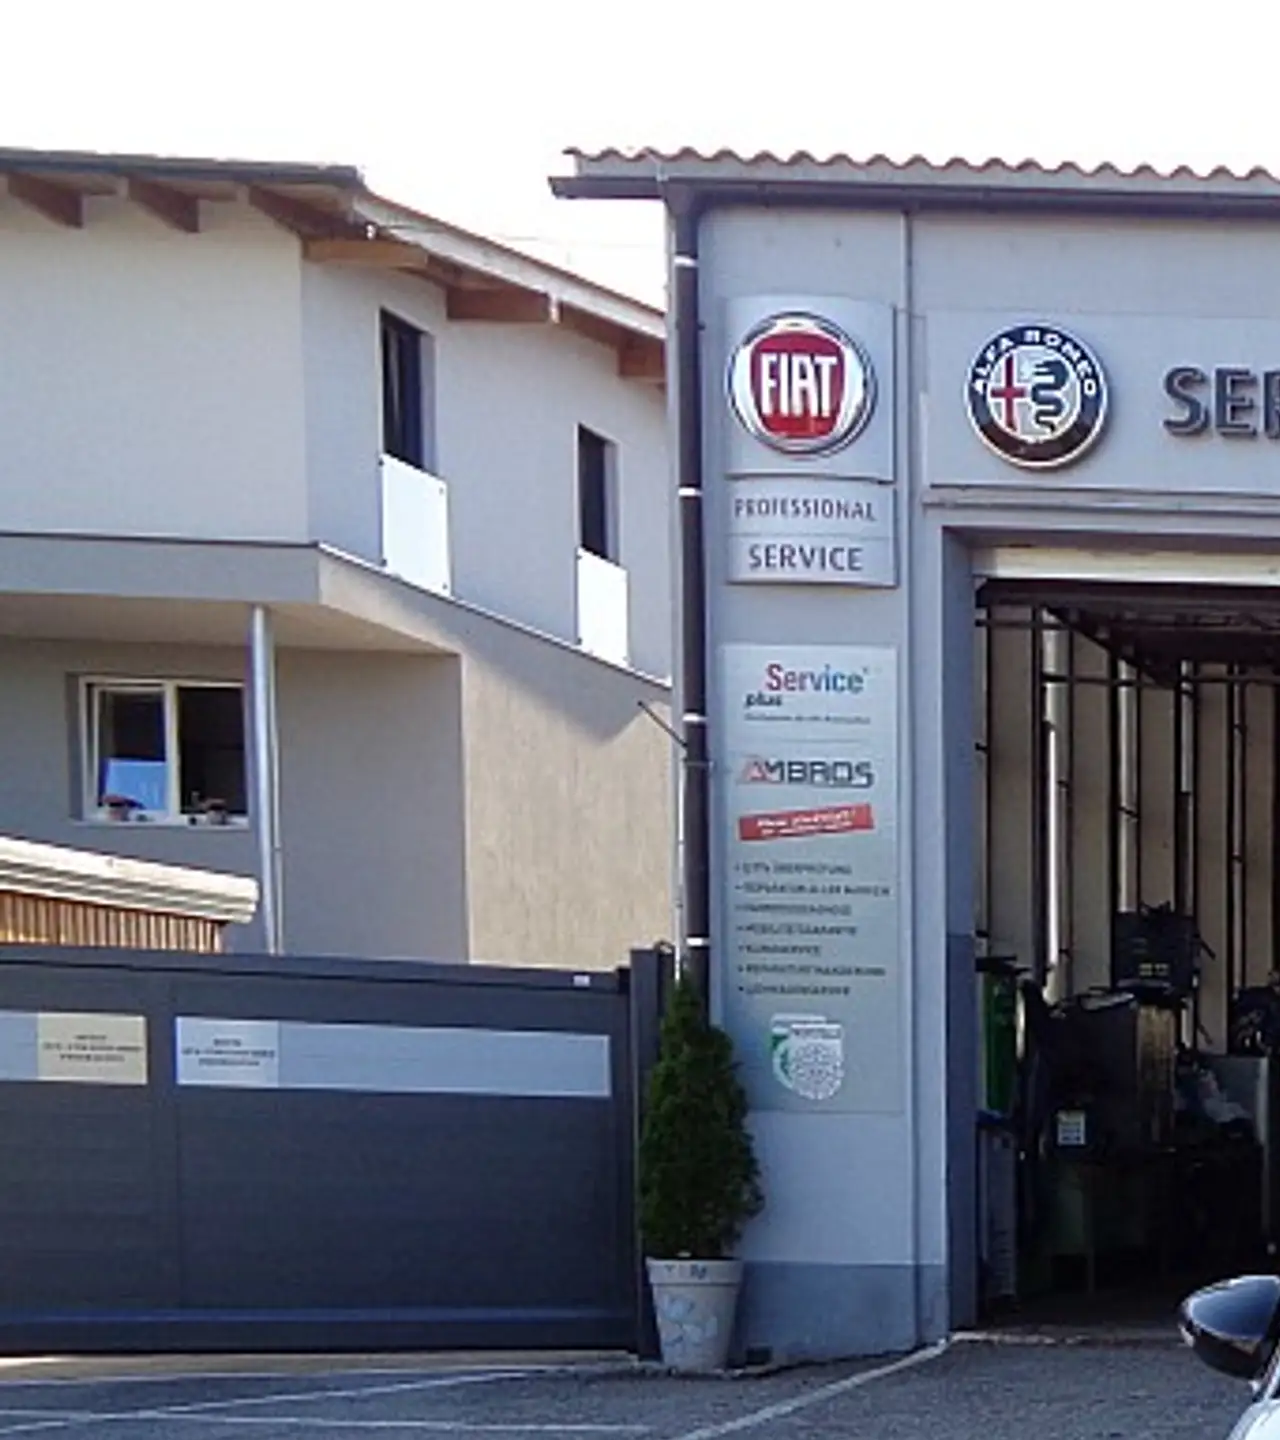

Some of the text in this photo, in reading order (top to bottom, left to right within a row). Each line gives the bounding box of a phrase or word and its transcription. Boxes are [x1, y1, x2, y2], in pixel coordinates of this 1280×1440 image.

[972, 329, 1098, 397] ALFA ROMEO
[761, 355, 836, 419] FIAT
[734, 498, 876, 523] PROFESSIONAL
[748, 543, 863, 572] SERVICE
[766, 663, 864, 693] Service
[737, 754, 876, 789] AMBROS
